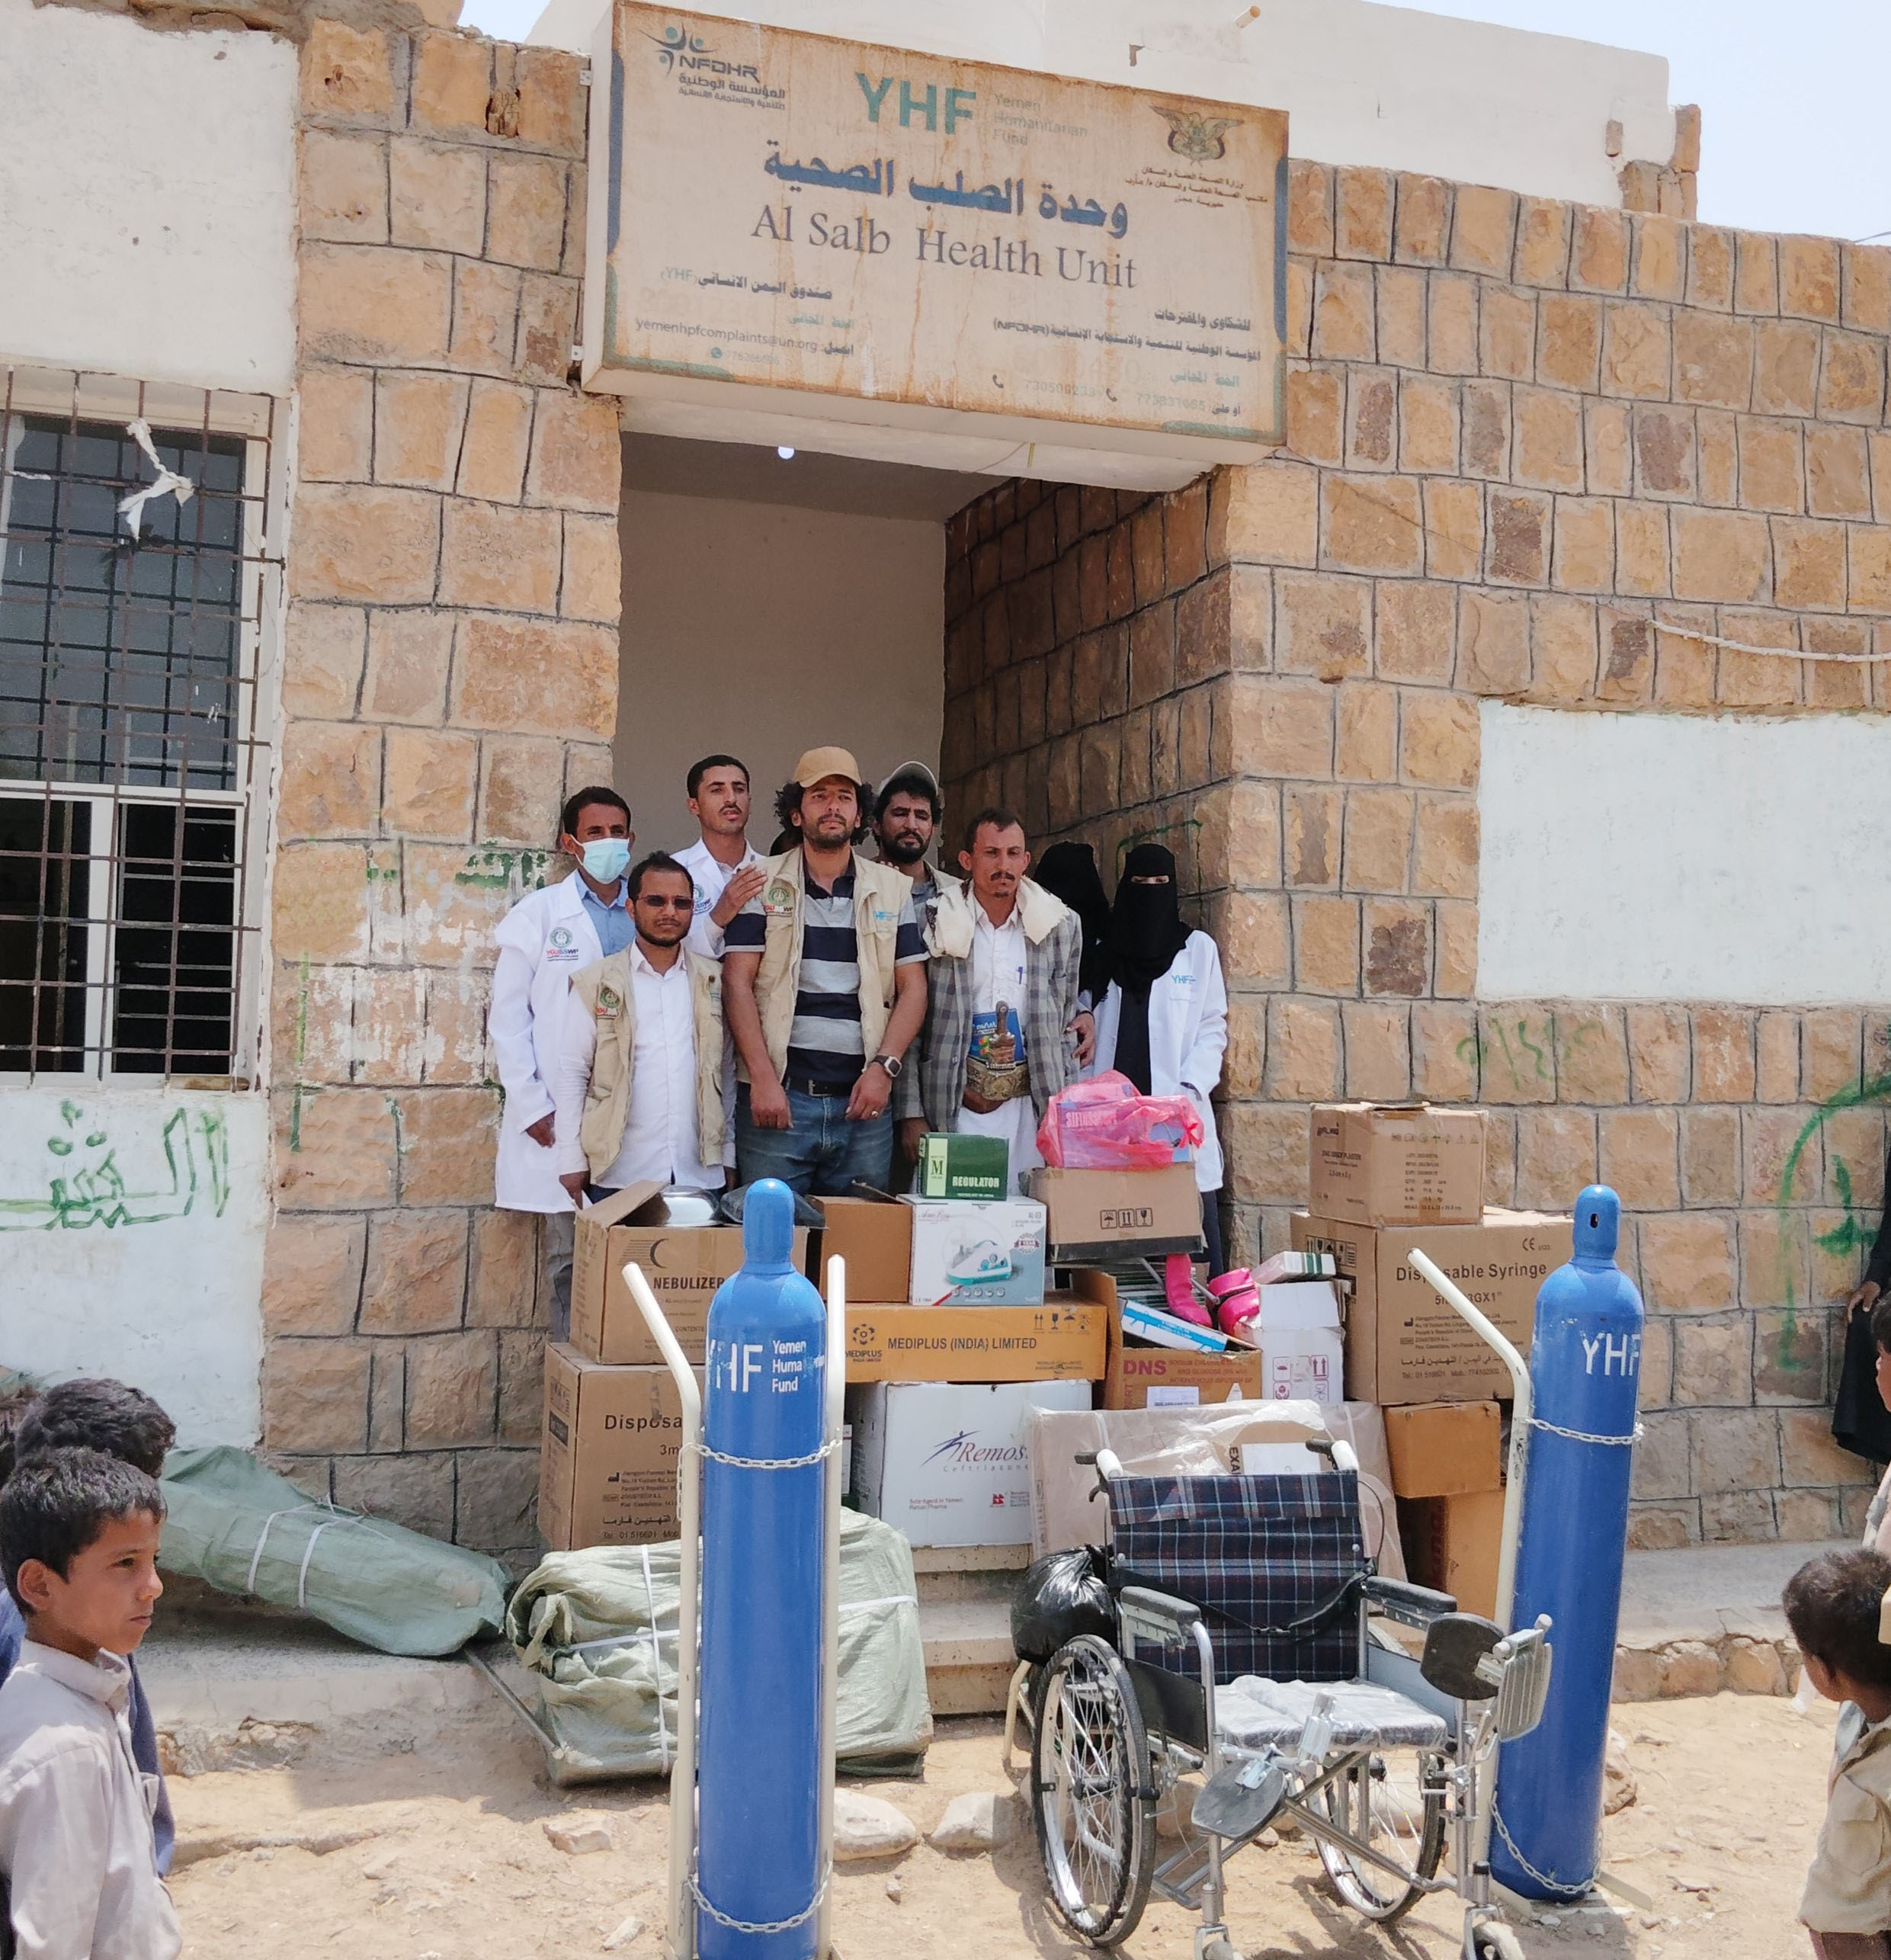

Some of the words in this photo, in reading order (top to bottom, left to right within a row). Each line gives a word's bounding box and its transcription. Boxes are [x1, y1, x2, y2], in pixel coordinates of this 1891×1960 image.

[679, 55, 761, 84] NFDHR
[678, 72, 725, 90] الوطنية
[729, 80, 786, 99] المؤسسة
[854, 72, 976, 135] YHF
[994, 92, 1041, 112] Yemen
[764, 140, 894, 198] الصحية
[909, 169, 1024, 217] الصلب
[1040, 182, 1128, 239] وحدة
[751, 204, 793, 242] Al
[809, 212, 891, 255] Salb
[917, 226, 1043, 277] Health
[1055, 245, 1138, 289] Unit
[789, 284, 833, 301] صندوق
[931, 1160, 944, 1175] M
[952, 1176, 1000, 1189] REGULATOR
[1396, 1264, 1484, 1284] Dissable
[1487, 1262, 1547, 1281] Syringe
[772, 1339, 806, 1354] Yemen
[888, 1337, 947, 1349] MEDIPLUS
[950, 1336, 989, 1352] (INDIA)
[992, 1336, 1037, 1349] LIMITED
[1579, 1330, 1640, 1376] YHF
[1123, 1359, 1167, 1375] DNS
[772, 1376, 799, 1393] Fund
[604, 1414, 683, 1433] Disposa
[659, 1445, 678, 1455] 3m
[956, 1442, 1028, 1462] Remos
[1229, 1446, 1242, 1475] EXA
